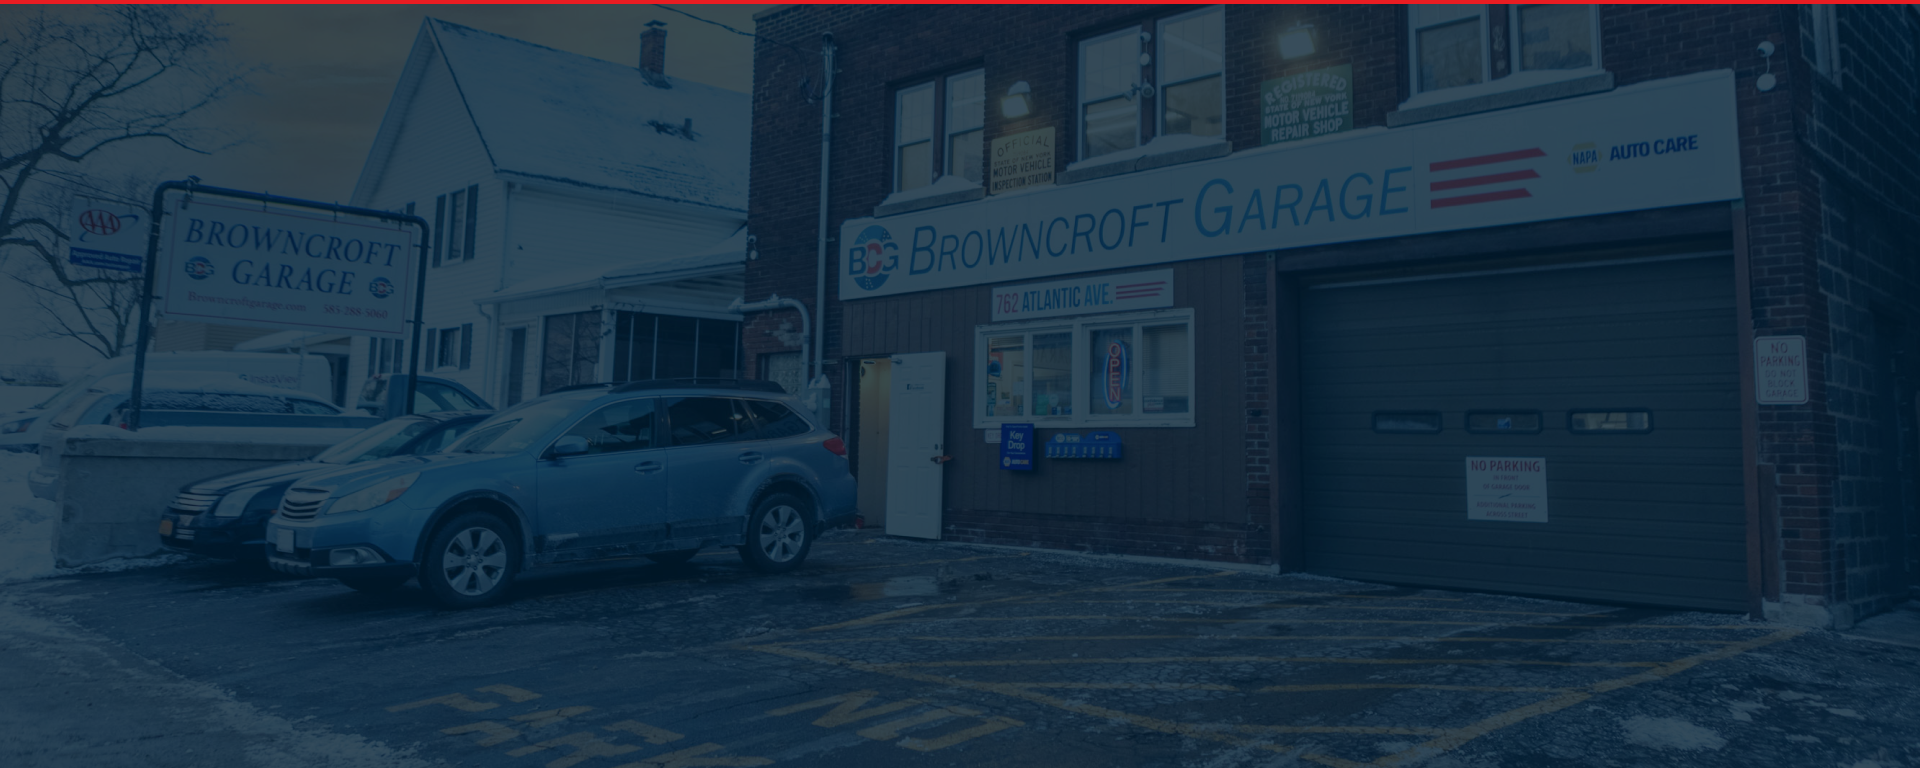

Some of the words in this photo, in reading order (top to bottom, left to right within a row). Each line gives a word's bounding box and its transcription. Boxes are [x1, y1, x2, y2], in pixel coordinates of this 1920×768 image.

[1264, 72, 1347, 105] REGISTERED
[1265, 103, 1289, 114] STATE
[1291, 100, 1302, 109] OF
[1304, 96, 1322, 107] NEW
[1324, 92, 1347, 103] YORK
[1264, 110, 1300, 129] MOTOR
[1302, 101, 1349, 121] VEHICLE
[1271, 123, 1309, 142] REPAIR
[1313, 117, 1343, 134] SHOP
[997, 134, 1049, 157] OFFICIAL
[1609, 141, 1650, 162] AUTO
[1653, 134, 1698, 155] CARE
[993, 164, 1018, 178] MOTOR
[1020, 157, 1051, 173] VEHICLE
[994, 159, 1010, 168] STATE
[1021, 154, 1033, 162] NEW
[1036, 151, 1051, 159] YORK
[1572, 149, 1598, 166] NAPA
[992, 176, 1026, 191] INSPECTION
[1027, 171, 1052, 185] STATION
[79, 208, 121, 236] AAA
[908, 197, 1184, 276] BROWNCROFT
[1194, 165, 1412, 238] GARAGE
[184, 217, 402, 267] BROWNCROFT
[848, 238, 900, 279] BCG
[231, 259, 356, 295] GARAGE
[188, 290, 306, 312] Browncroftgarage.com
[996, 292, 1019, 314] 762
[1021, 286, 1081, 312] ATLANTIC
[1084, 283, 1113, 307] AVE.
[323, 303, 388, 320] 585-288-5060
[1770, 342, 1789, 354] NO
[1760, 354, 1801, 368] PARKING
[1108, 342, 1121, 402] OPEN
[1765, 369, 1777, 378] DO
[1780, 369, 1797, 378] NOT
[1765, 389, 1799, 398] GARAGE
[1767, 379, 1795, 388] BLOCK
[1007, 440, 1026, 451] Drop
[1009, 430, 1024, 442] Key
[1471, 460, 1487, 472] NO
[1490, 460, 1541, 472] PARKING
[1501, 474, 1519, 482] FRONT
[1511, 502, 1536, 510] PARKING
